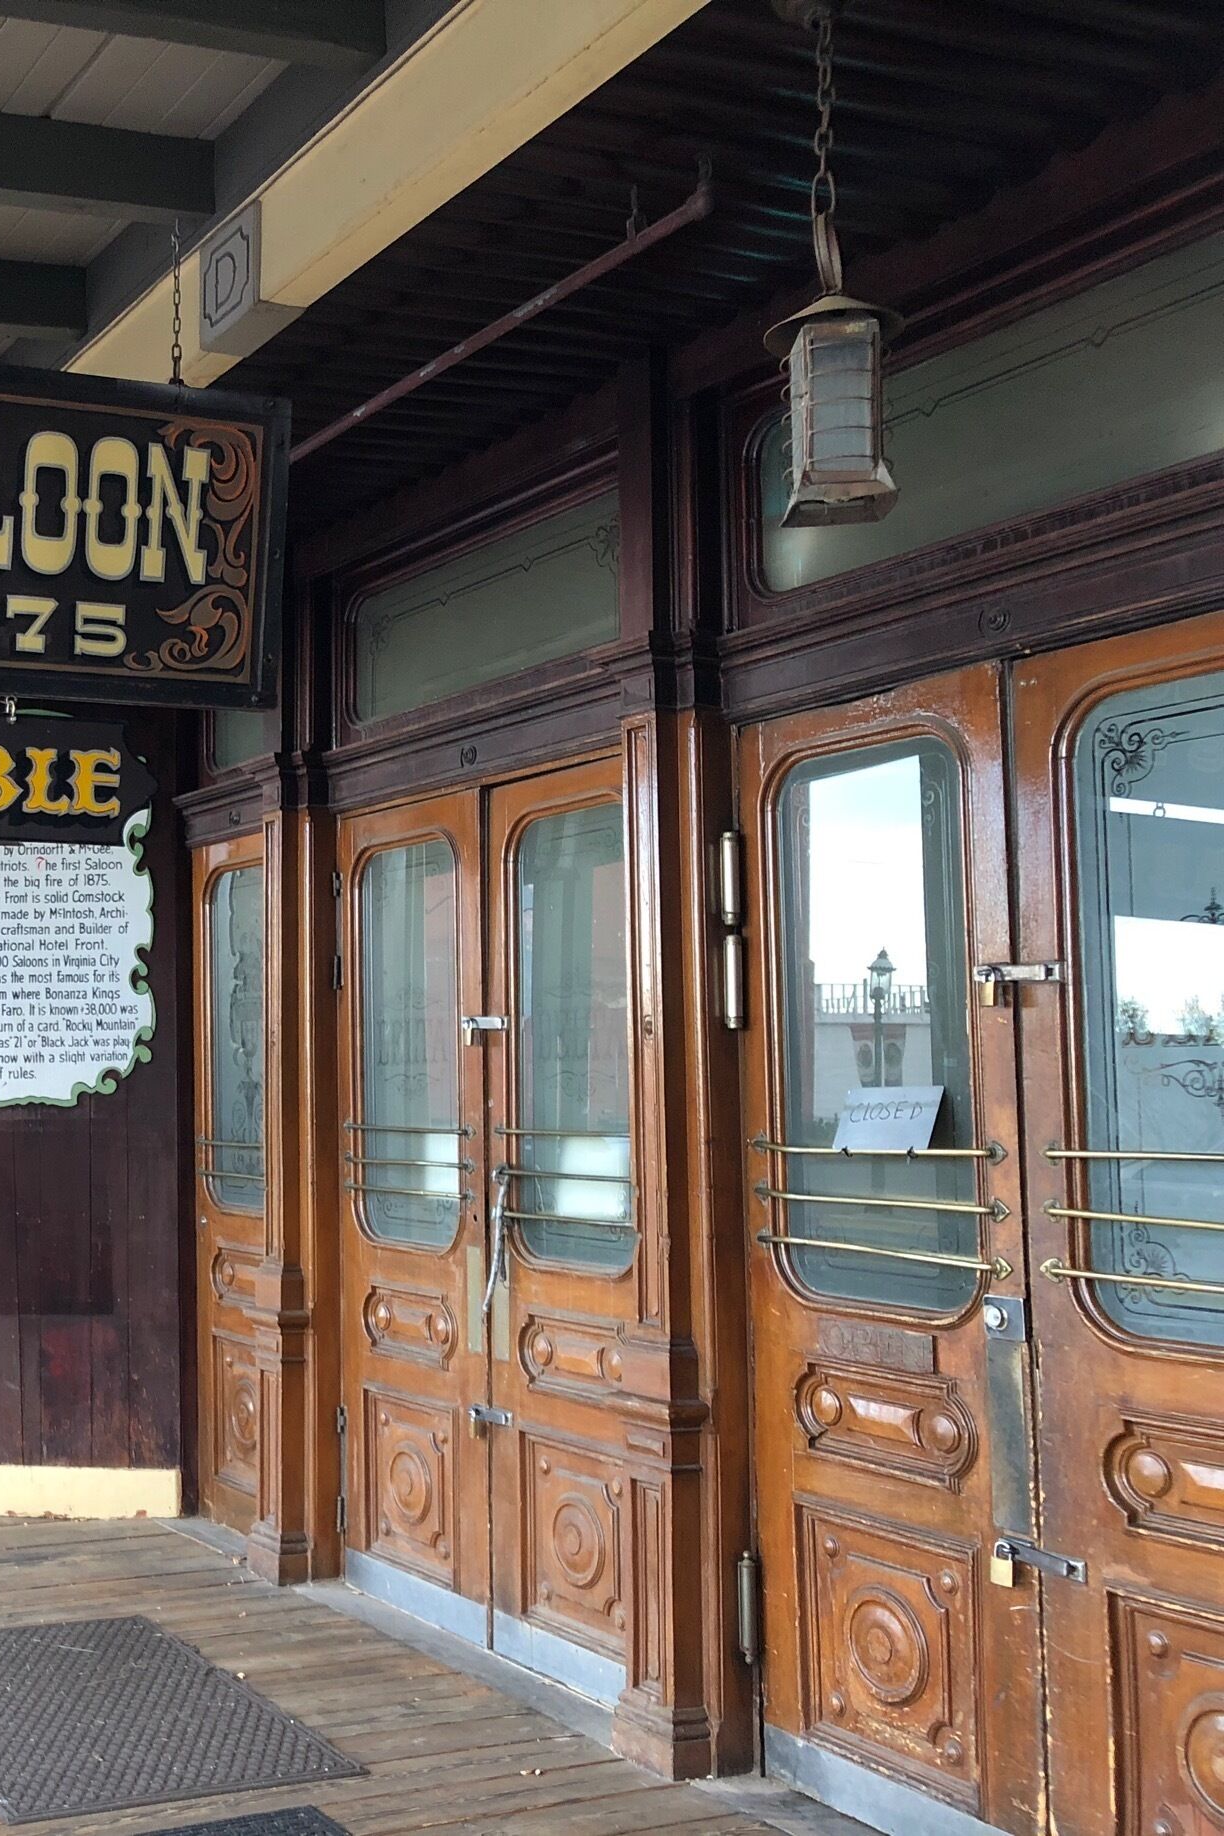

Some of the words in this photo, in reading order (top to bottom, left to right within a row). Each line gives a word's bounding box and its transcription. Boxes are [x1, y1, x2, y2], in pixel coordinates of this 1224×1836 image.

[4, 845, 14, 858] by
[35, 856, 57, 872] The
[61, 857, 81, 870] first
[85, 858, 123, 870] Saloon
[3, 876, 19, 888] the
[24, 875, 40, 889] big
[45, 874, 63, 887] fire
[68, 874, 80, 887] of
[83, 874, 111, 887] 1875.
[5, 892, 28, 904] Front
[31, 892, 40, 903] is
[44, 891, 69, 903] solid
[72, 890, 125, 903] Comstock
[1, 908, 29, 920] made
[34, 908, 46, 922] by
[1, 923, 51, 936] craftsman
[55, 923, 75, 935] and
[79, 922, 112, 935] Builder
[118, 922, 130, 935] of
[39, 939, 68, 951] Hotel
[75, 938, 108, 951] Front.
[12, 955, 48, 967] Saloons
[52, 955, 60, 967] in
[63, 954, 96, 969] Virginia
[99, 953, 120, 968] City
[11, 971, 25, 984] the
[29, 971, 53, 983] most
[57, 971, 89, 983] famous
[93, 970, 105, 983] for
[12, 988, 41, 1000] where
[45, 987, 87, 1000] Bonanza
[92, 986, 121, 1002] Kings
[1, 1003, 25, 1016] Faro.
[29, 1003, 36, 1016] It
[38, 1003, 46, 1016] is
[49, 1003, 79, 1015] known
[120, 1004, 139, 1015] was
[16, 1019, 26, 1032] of
[28, 1023, 34, 1032] a
[37, 1019, 60, 1032] card.
[28, 1037, 37, 1048] or
[93, 1037, 110, 1047] was
[23, 1051, 45, 1063] with
[48, 1053, 55, 1063] a
[59, 1050, 86, 1064] slight
[90, 1049, 128, 1062] variation
[8, 1066, 37, 1080] rules.
[849, 1100, 924, 1124] CLOSED
